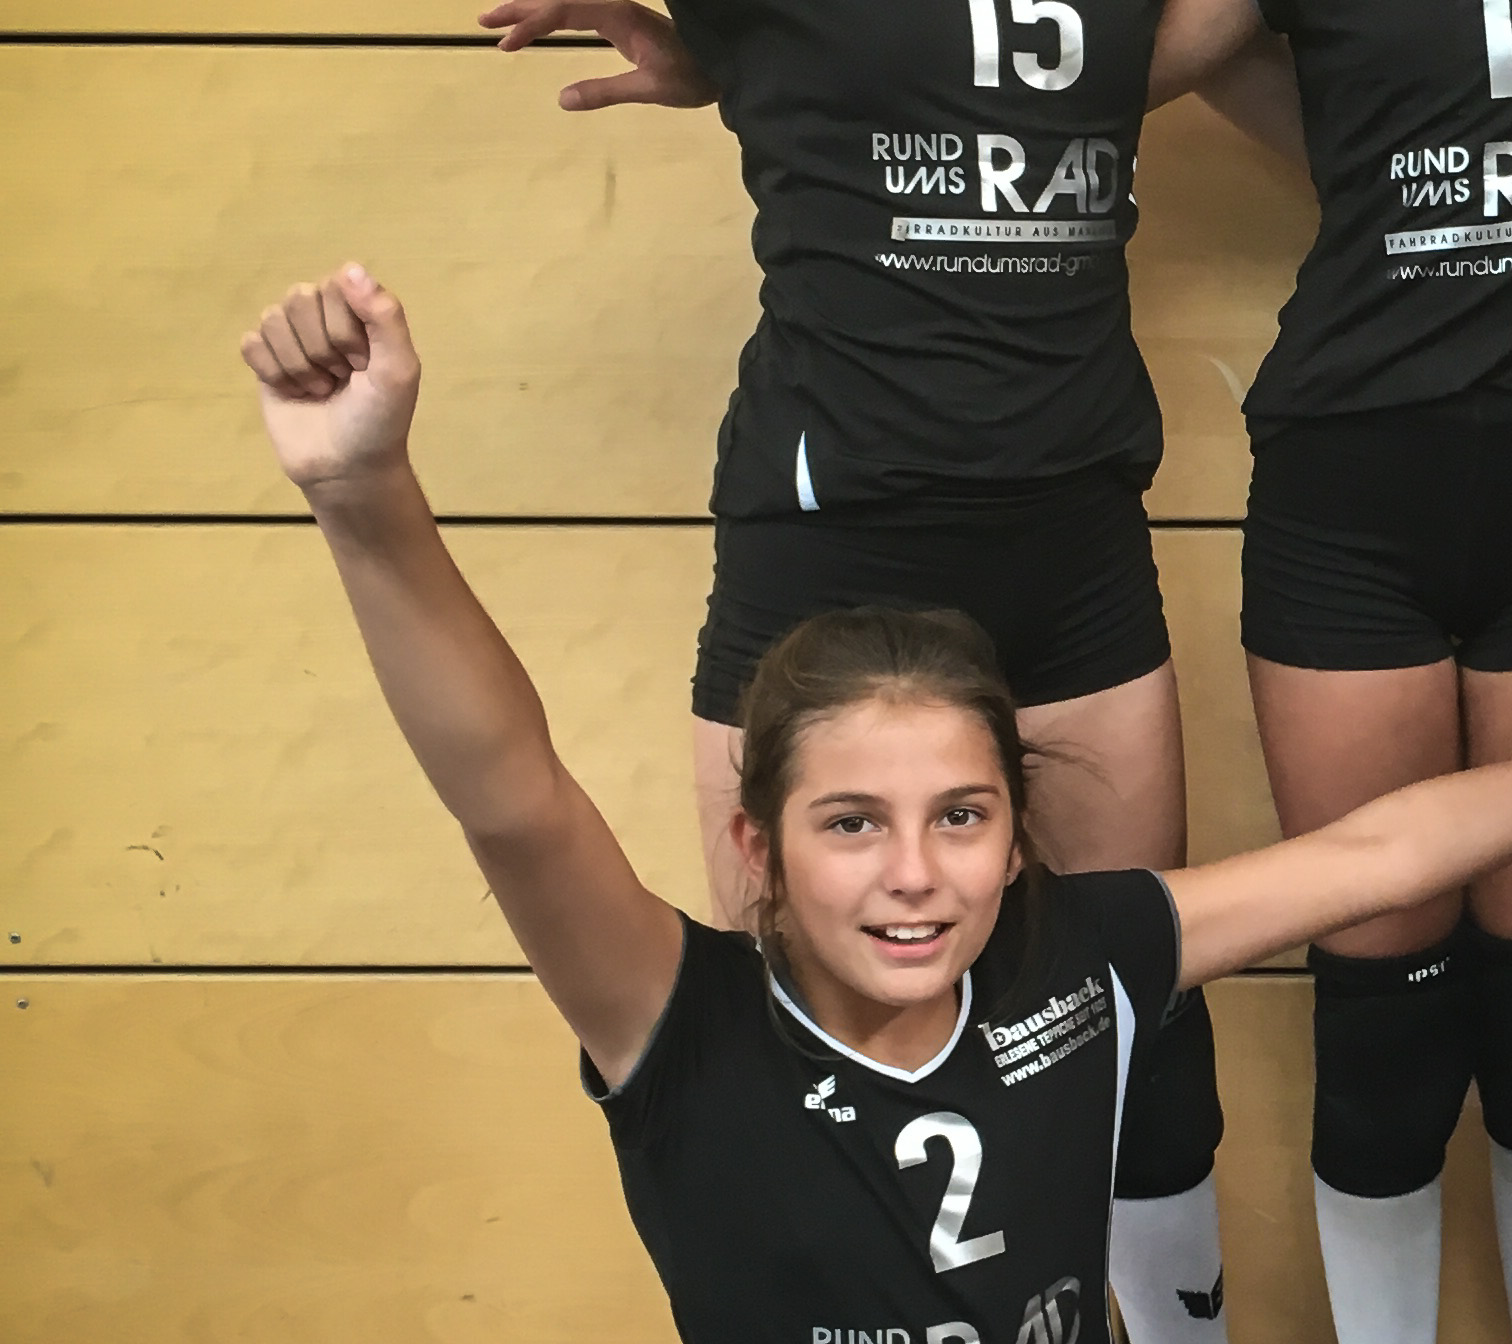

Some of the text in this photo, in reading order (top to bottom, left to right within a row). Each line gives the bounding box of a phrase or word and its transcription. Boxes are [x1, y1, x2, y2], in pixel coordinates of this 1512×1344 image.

[872, 133, 963, 161] RUND
[977, 134, 1120, 213] RAD
[1391, 146, 1469, 180] RUND
[886, 165, 966, 194] UMS
[1402, 178, 1470, 206] UMS
[896, 222, 1022, 237] RRADKULTUR
[1032, 226, 1059, 237] AUS
[978, 976, 1105, 1051] bausback
[994, 1038, 1040, 1068] ERLESENE
[1001, 1016, 1111, 1087] www.bausback.de
[804, 1093, 856, 1123] ema
[895, 1112, 1006, 1274] 2
